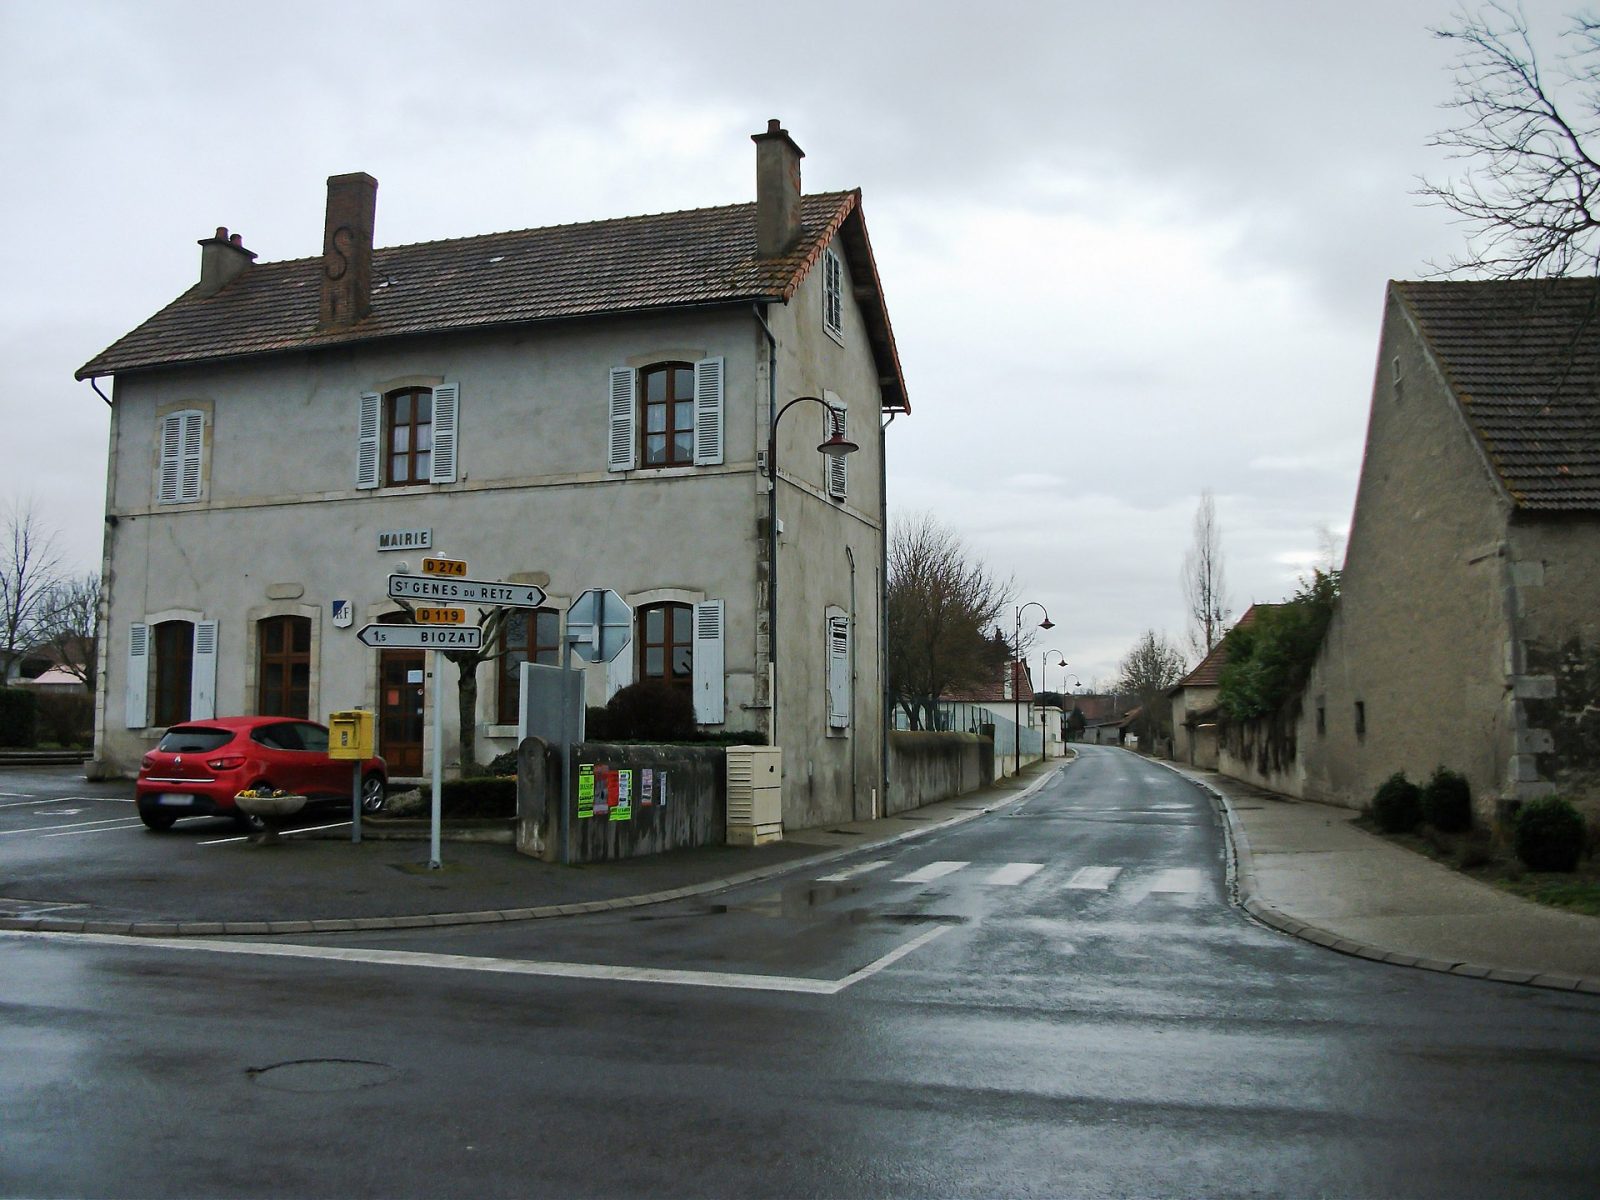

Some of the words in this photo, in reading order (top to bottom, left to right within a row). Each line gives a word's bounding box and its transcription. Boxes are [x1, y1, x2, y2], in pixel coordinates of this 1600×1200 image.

[379, 531, 428, 547] MAIRIE
[427, 562, 434, 571] D
[439, 562, 463, 573] 274
[413, 582, 458, 596] GENES
[464, 590, 475, 598] DU
[481, 587, 513, 600] RETZ
[526, 591, 534, 602] 4
[336, 607, 350, 619] RF
[422, 610, 429, 621] D
[434, 610, 459, 621] 119
[373, 630, 387, 643] 1,5
[421, 631, 475, 643] BIOZAT
